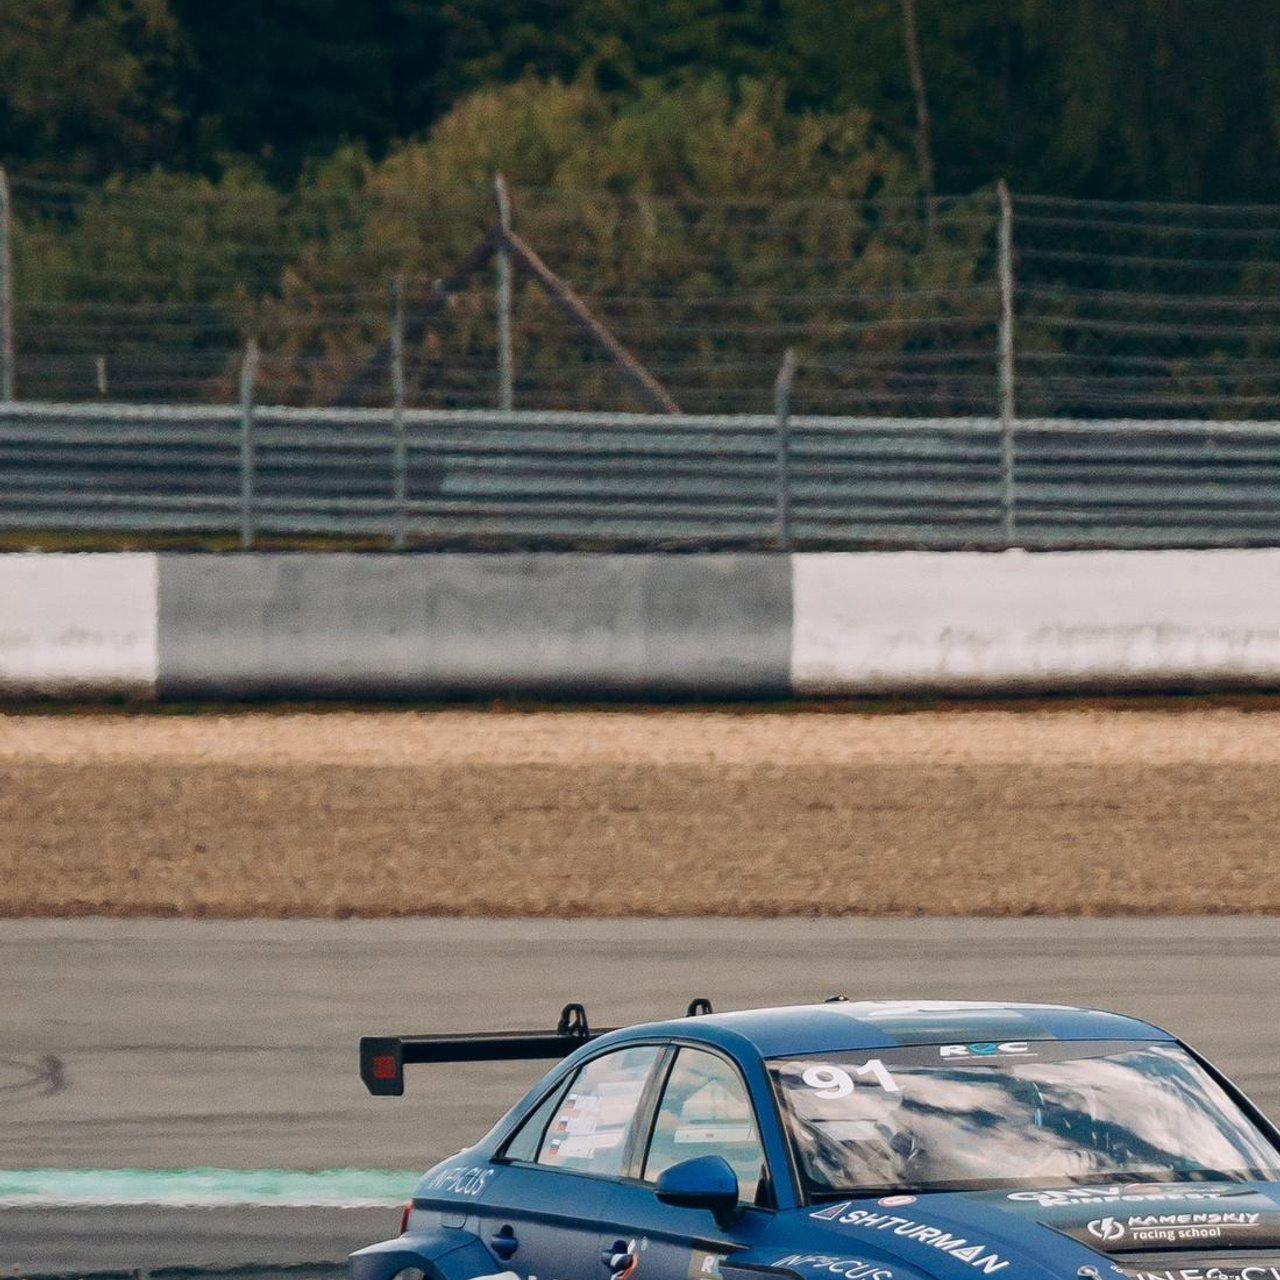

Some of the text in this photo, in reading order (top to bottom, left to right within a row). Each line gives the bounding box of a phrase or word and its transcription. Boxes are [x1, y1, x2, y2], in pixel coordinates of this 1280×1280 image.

[802, 1058, 899, 1099] 91
[1128, 1213, 1260, 1227] KAMENSKIY
[838, 1210, 1010, 1274] SHTURMAN
[1133, 1228, 1221, 1241] racing school
